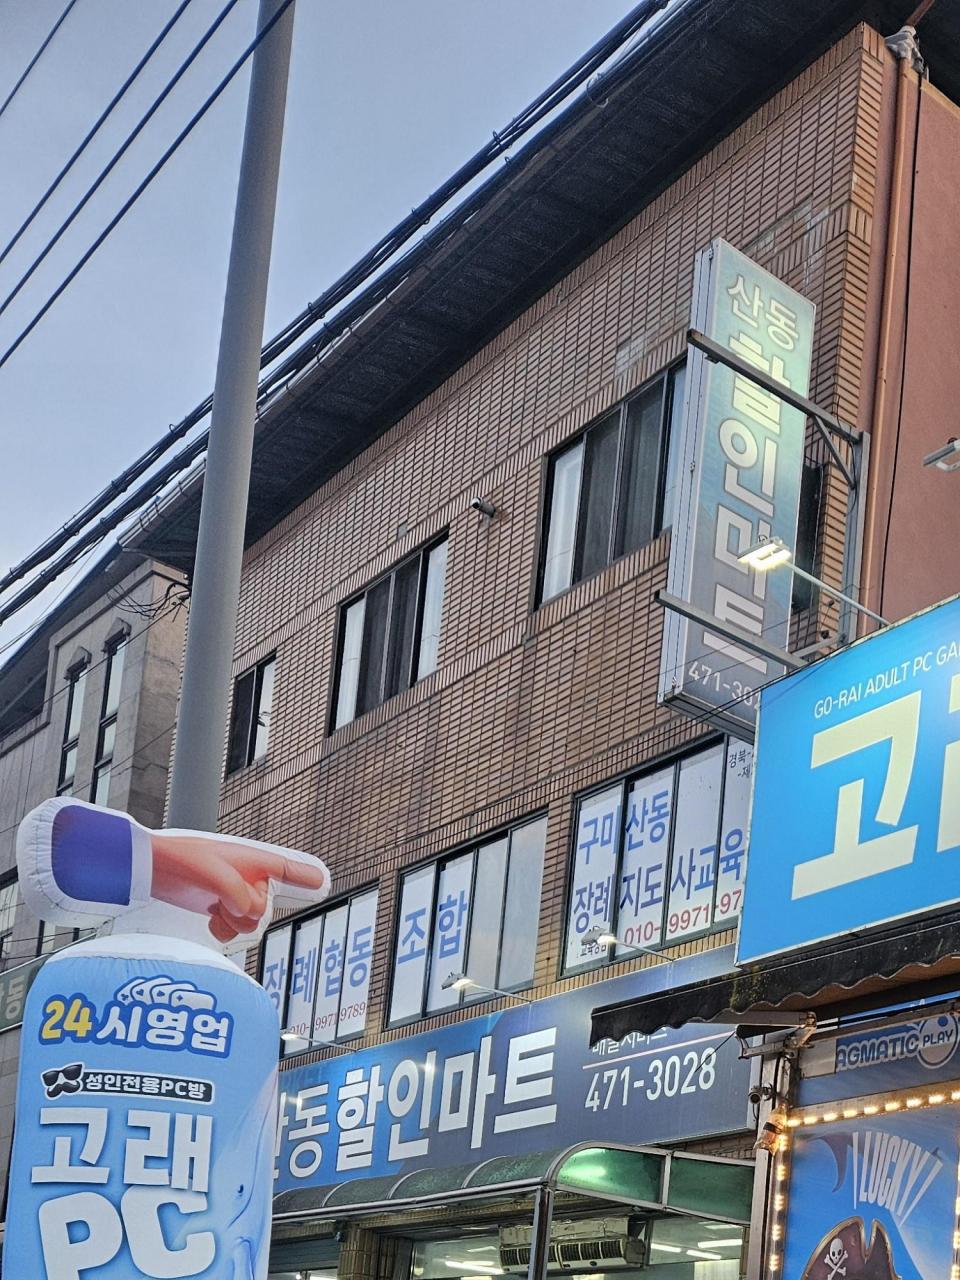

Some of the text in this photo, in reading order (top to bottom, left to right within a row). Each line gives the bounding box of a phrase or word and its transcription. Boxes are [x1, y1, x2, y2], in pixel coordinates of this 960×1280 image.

[727, 273, 800, 352] 산동
[703, 334, 791, 675] 할인마트
[814, 684, 862, 719] GO-RAI
[864, 667, 909, 701] ADULT
[913, 651, 932, 680] PC
[922, 1029, 954, 1048] PLAY
[85, 1072, 206, 1099] 성인전용PC방
[584, 1047, 717, 1112] 471-3028
[31, 1107, 213, 1193] 고래
